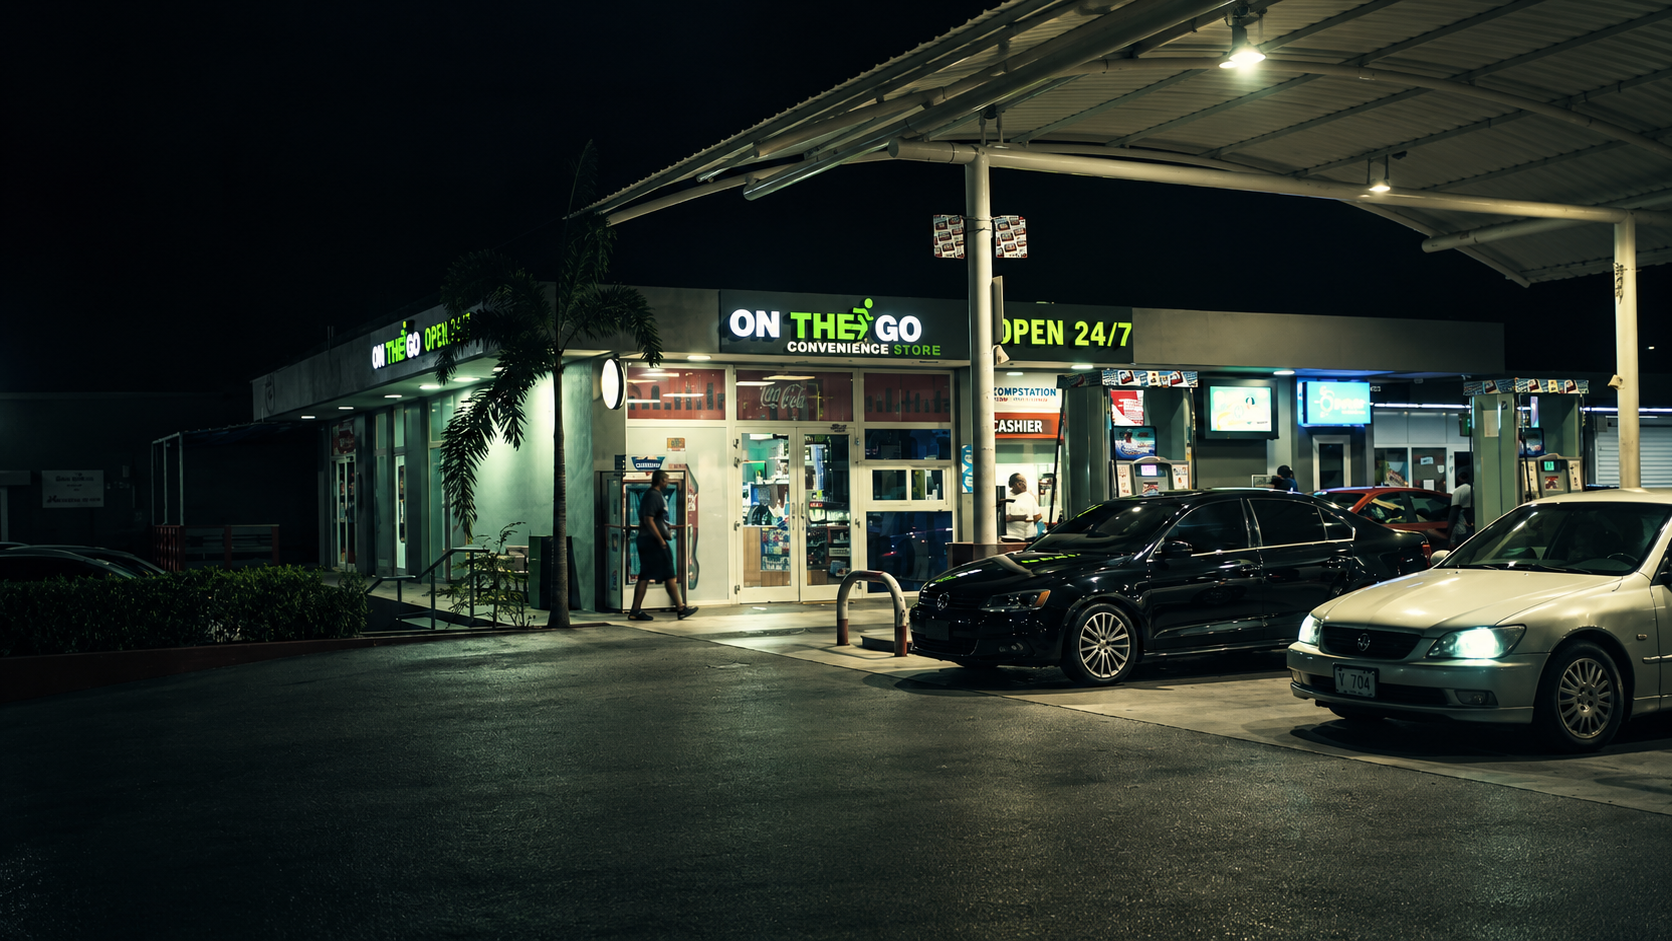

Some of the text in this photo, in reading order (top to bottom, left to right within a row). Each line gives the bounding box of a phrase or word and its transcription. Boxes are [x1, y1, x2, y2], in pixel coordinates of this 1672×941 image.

[729, 308, 922, 343] ON THE GO
[1001, 318, 1132, 347] OPEN 24/7
[372, 343, 385, 370] ON
[385, 336, 405, 365] THE
[406, 331, 421, 358] GO
[425, 321, 449, 352] OPEN
[787, 341, 941, 356] CONVENIENCE STORE
